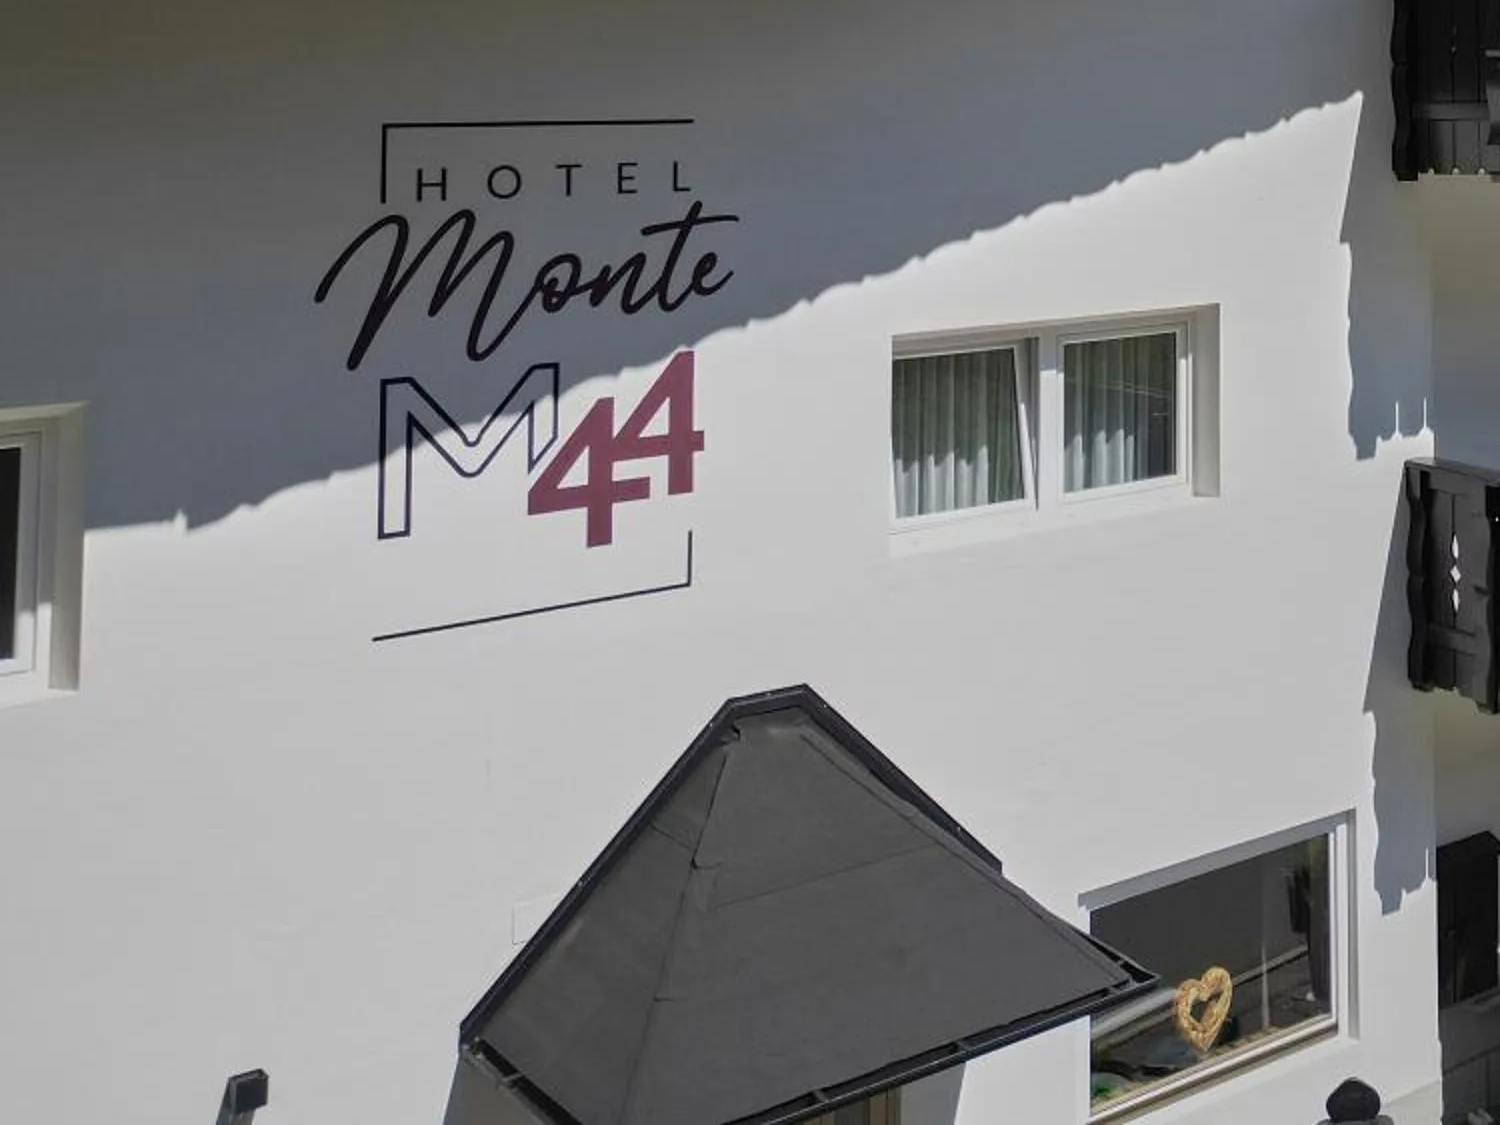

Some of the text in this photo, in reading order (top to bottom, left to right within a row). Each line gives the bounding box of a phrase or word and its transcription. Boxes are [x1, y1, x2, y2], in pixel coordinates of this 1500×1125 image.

[415, 161, 692, 202] HOTEL
[314, 200, 739, 371] Monte
[377, 350, 705, 548] M44
